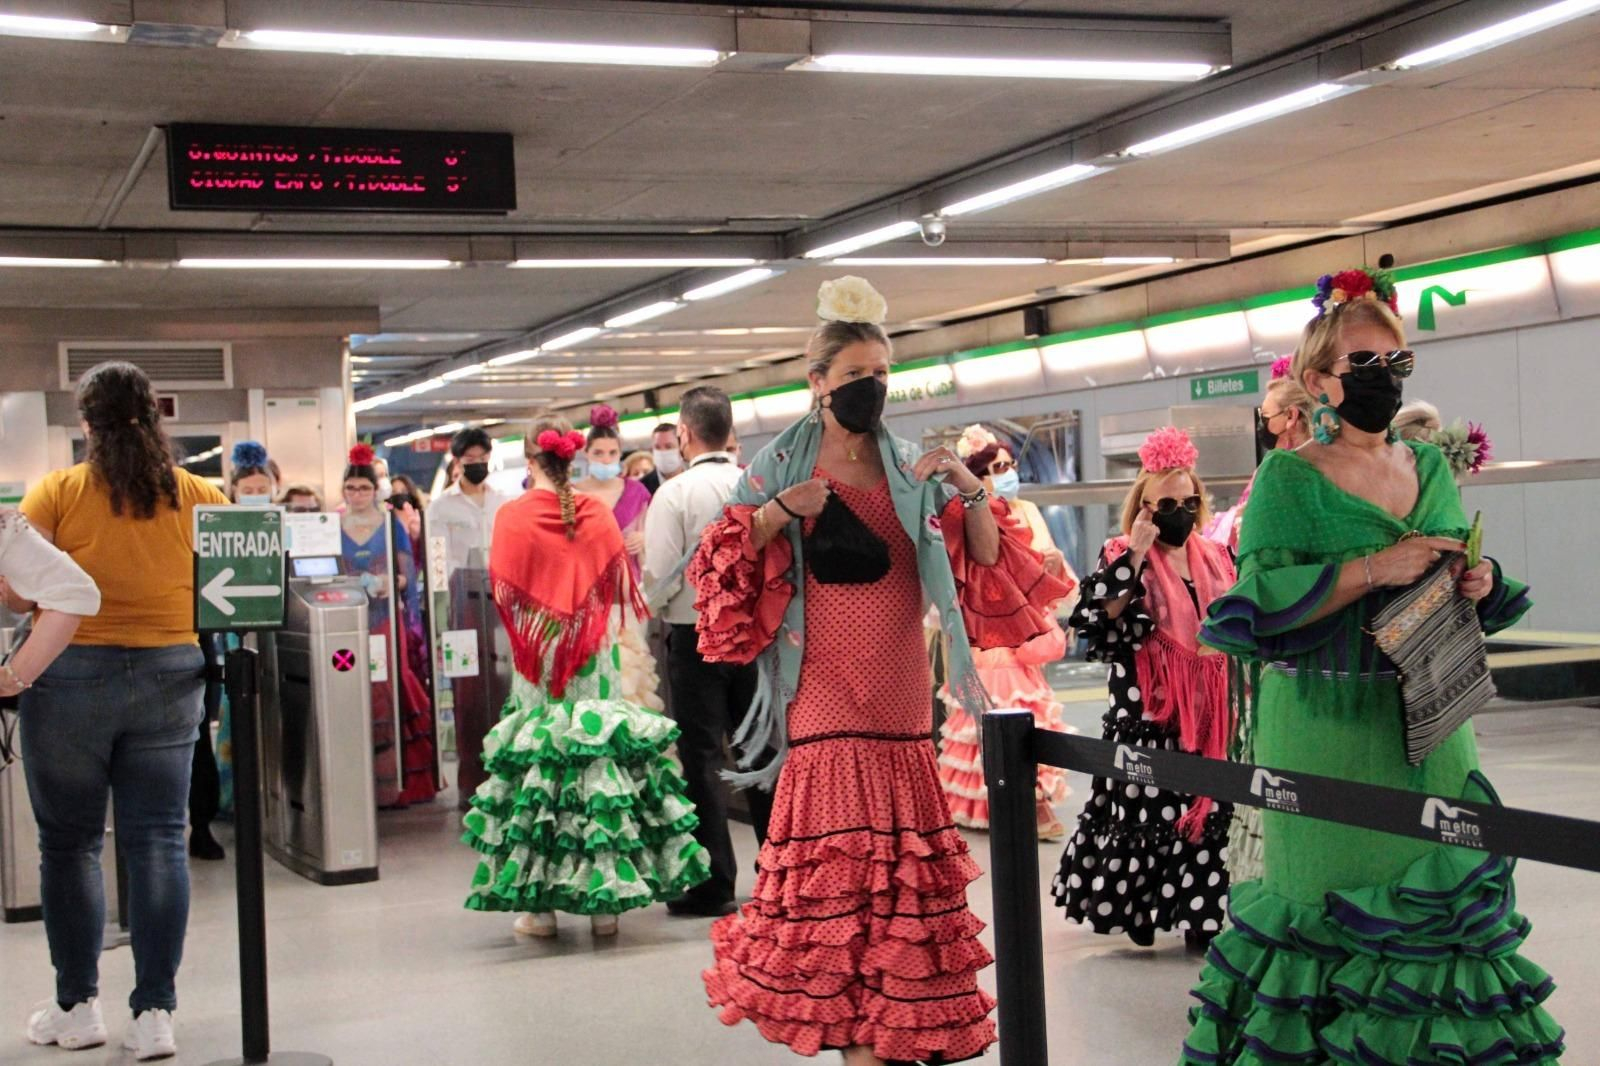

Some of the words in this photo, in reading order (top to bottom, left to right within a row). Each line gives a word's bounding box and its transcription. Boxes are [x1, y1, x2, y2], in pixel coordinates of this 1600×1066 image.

[190, 171, 264, 188] CIUDAD
[1208, 378, 1244, 395] Billetes
[199, 530, 281, 557] ENTRADA
[1126, 762, 1153, 775] metro
[1265, 787, 1298, 802] metro
[1440, 820, 1480, 836] metro
